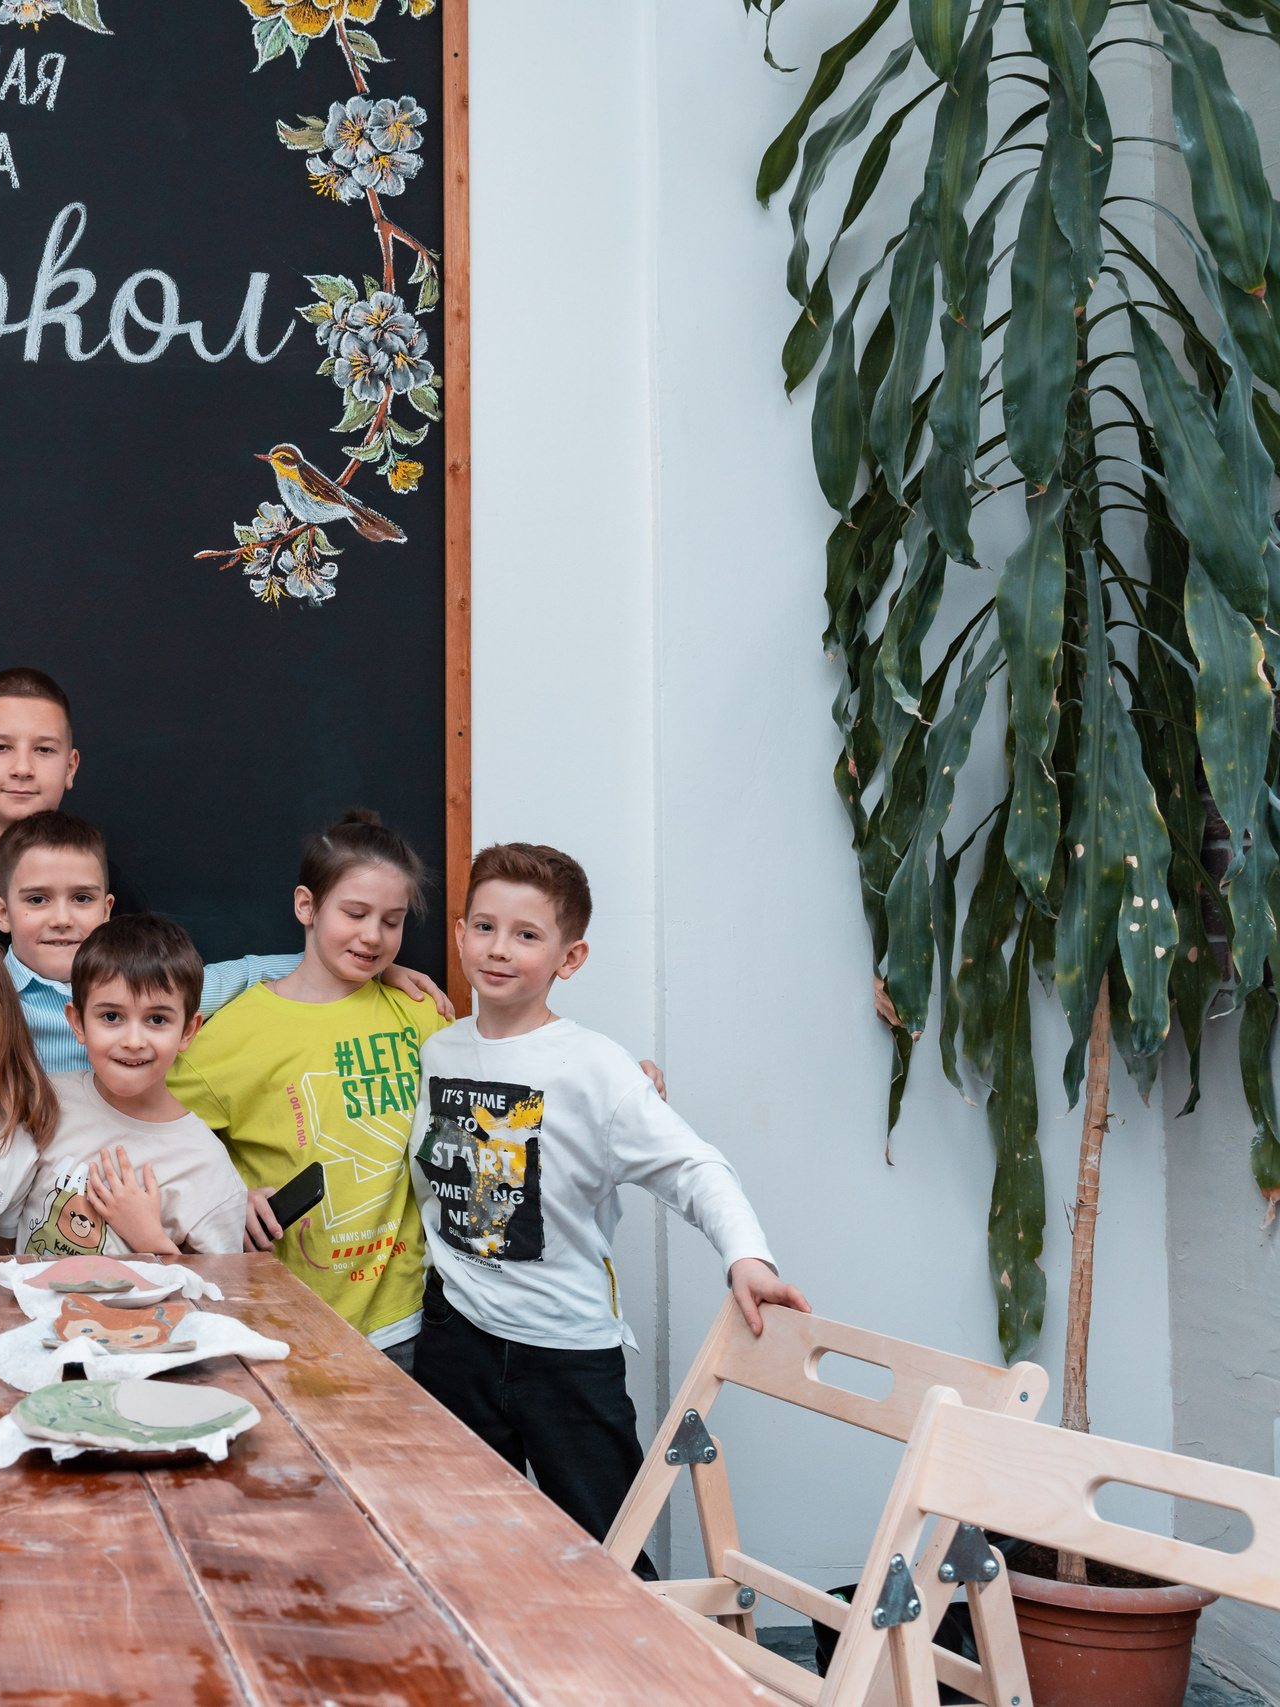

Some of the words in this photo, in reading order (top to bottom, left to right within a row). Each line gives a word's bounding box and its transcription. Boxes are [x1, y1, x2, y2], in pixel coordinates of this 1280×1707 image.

[334, 1027, 420, 1077] #LET'S
[290, 1097, 301, 1111] DO
[342, 1069, 420, 1119] STAR
[441, 1089, 464, 1105] IT'S
[468, 1091, 506, 1110] TIME
[294, 1112, 304, 1128] CAN
[457, 1116, 478, 1133] TO
[296, 1129, 308, 1149] YOU
[431, 1141, 516, 1177] START
[448, 1210, 469, 1226] NE
[331, 1231, 359, 1243] ALWAYS
[377, 1224, 388, 1235] AND
[387, 1220, 398, 1231] BE
[475, 1258, 502, 1270] STRONGER
